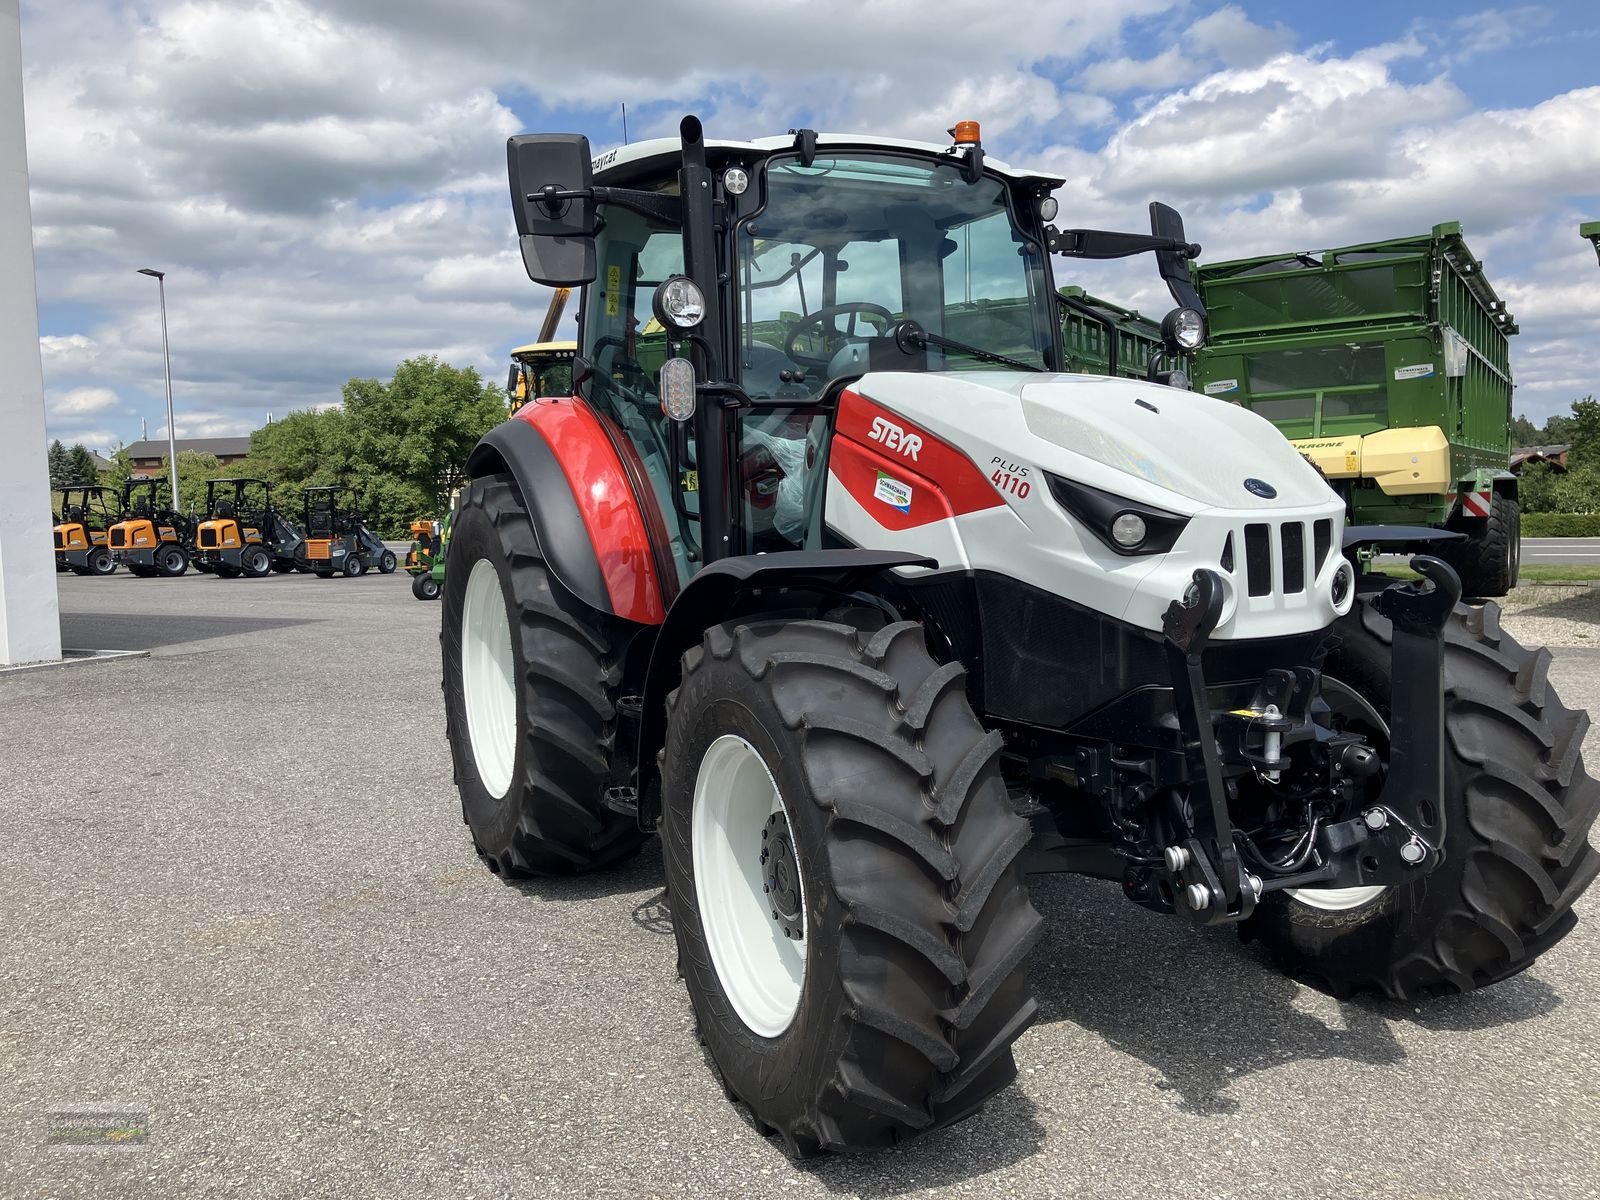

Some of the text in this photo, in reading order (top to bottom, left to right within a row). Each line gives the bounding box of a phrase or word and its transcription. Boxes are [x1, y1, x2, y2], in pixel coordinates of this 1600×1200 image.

[867, 416, 923, 462] STEYR
[1297, 441, 1345, 450] KRONE
[990, 456, 1030, 477] PLUS
[991, 469, 1031, 499] 4110
